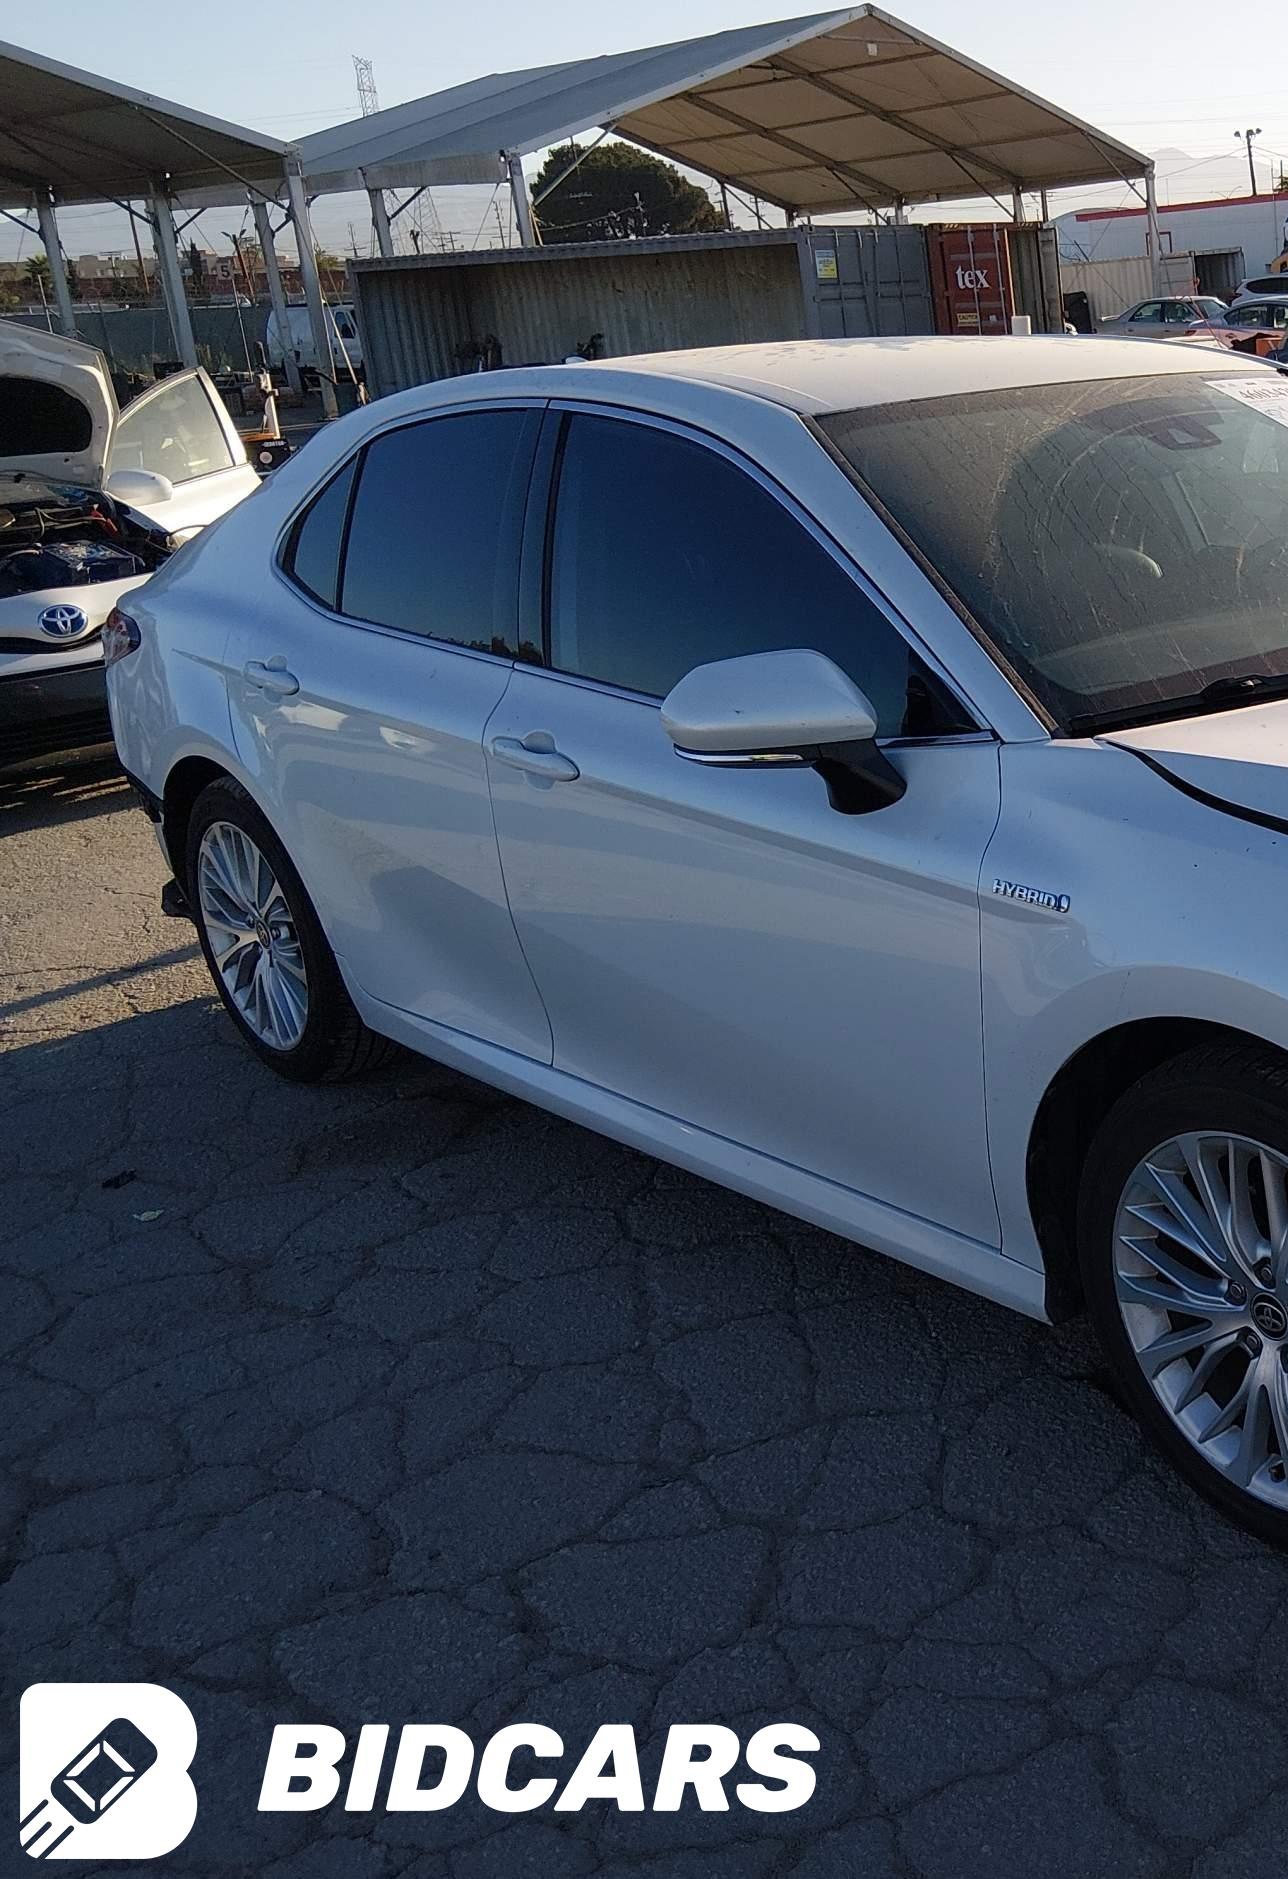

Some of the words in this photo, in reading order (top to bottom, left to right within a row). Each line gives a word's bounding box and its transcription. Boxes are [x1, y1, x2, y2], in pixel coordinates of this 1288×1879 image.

[220, 264, 231, 278] 5
[955, 264, 991, 290] tex
[992, 879, 1059, 911] HYBRID
